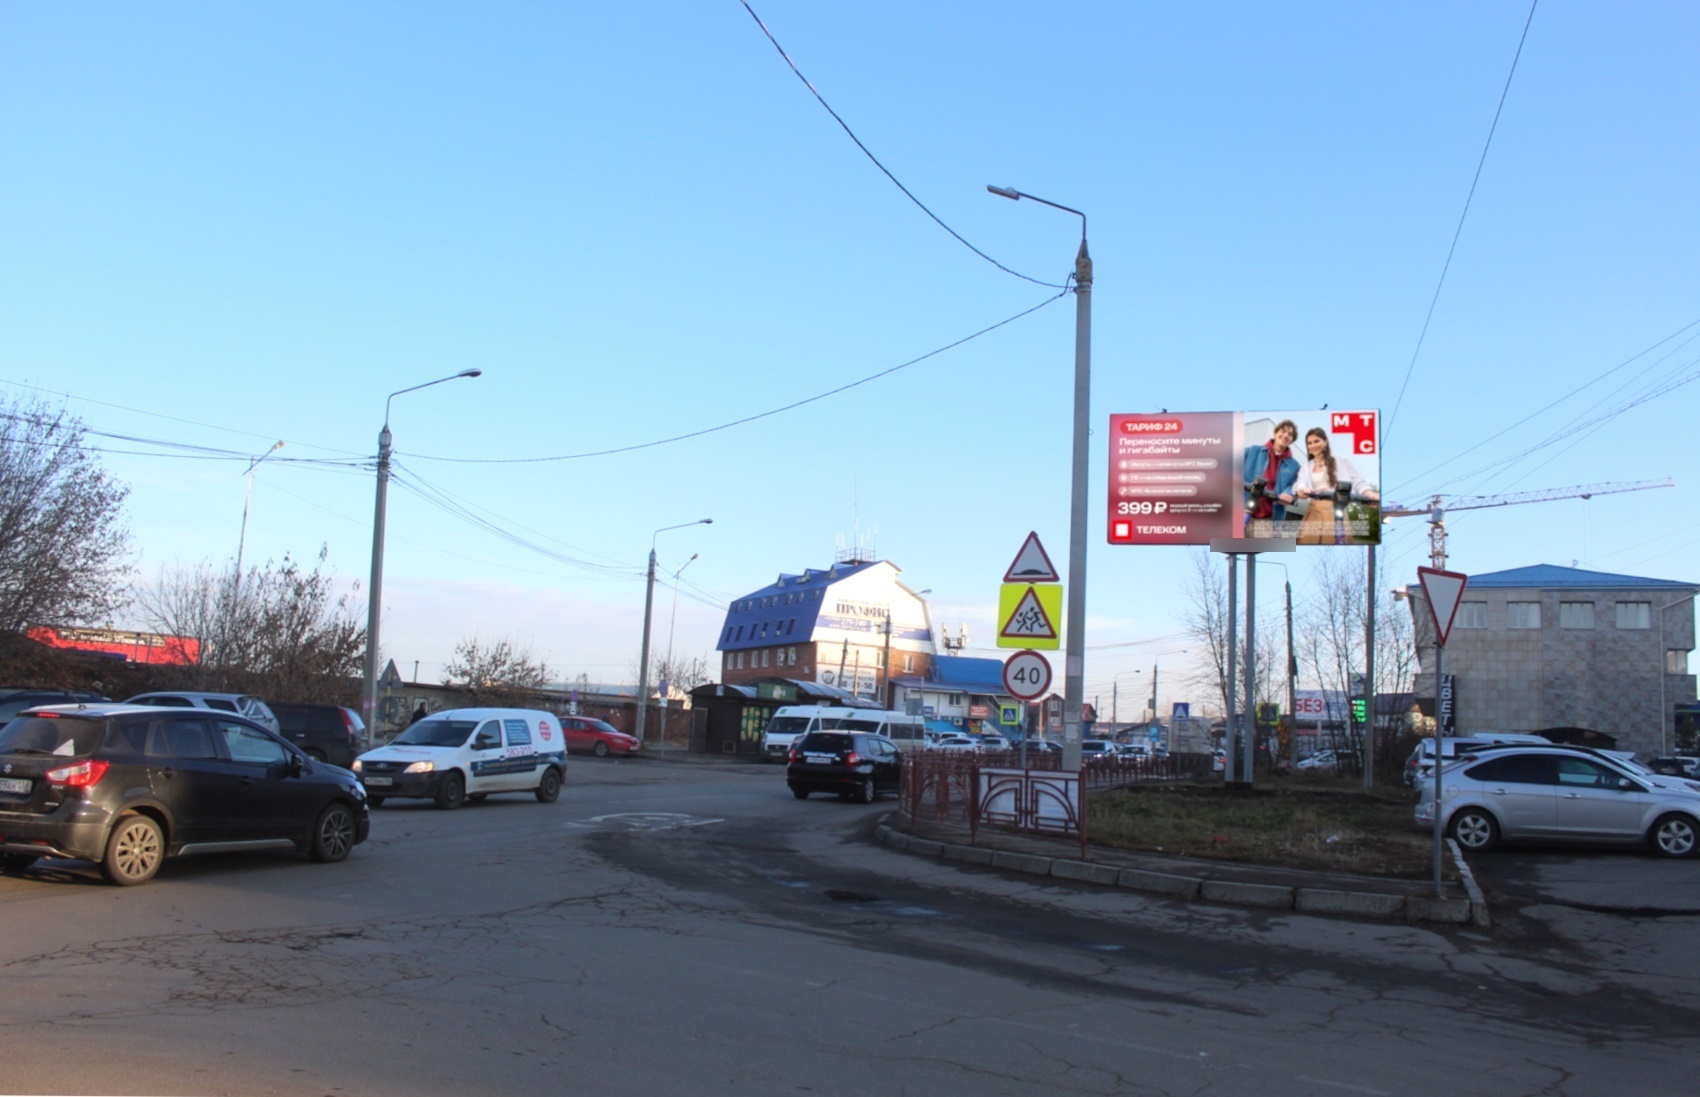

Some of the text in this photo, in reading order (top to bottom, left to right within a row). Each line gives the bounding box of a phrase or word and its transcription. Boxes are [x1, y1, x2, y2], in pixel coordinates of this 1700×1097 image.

[1126, 423, 1178, 431] ТАРИФ 24
[1119, 437, 1221, 447] Переносите минуты
[1127, 446, 1181, 454] гигабайты
[1118, 502, 1152, 514] 399
[1136, 526, 1187, 534] ТЕЛЕКОМ
[1013, 667, 1040, 684] 40
